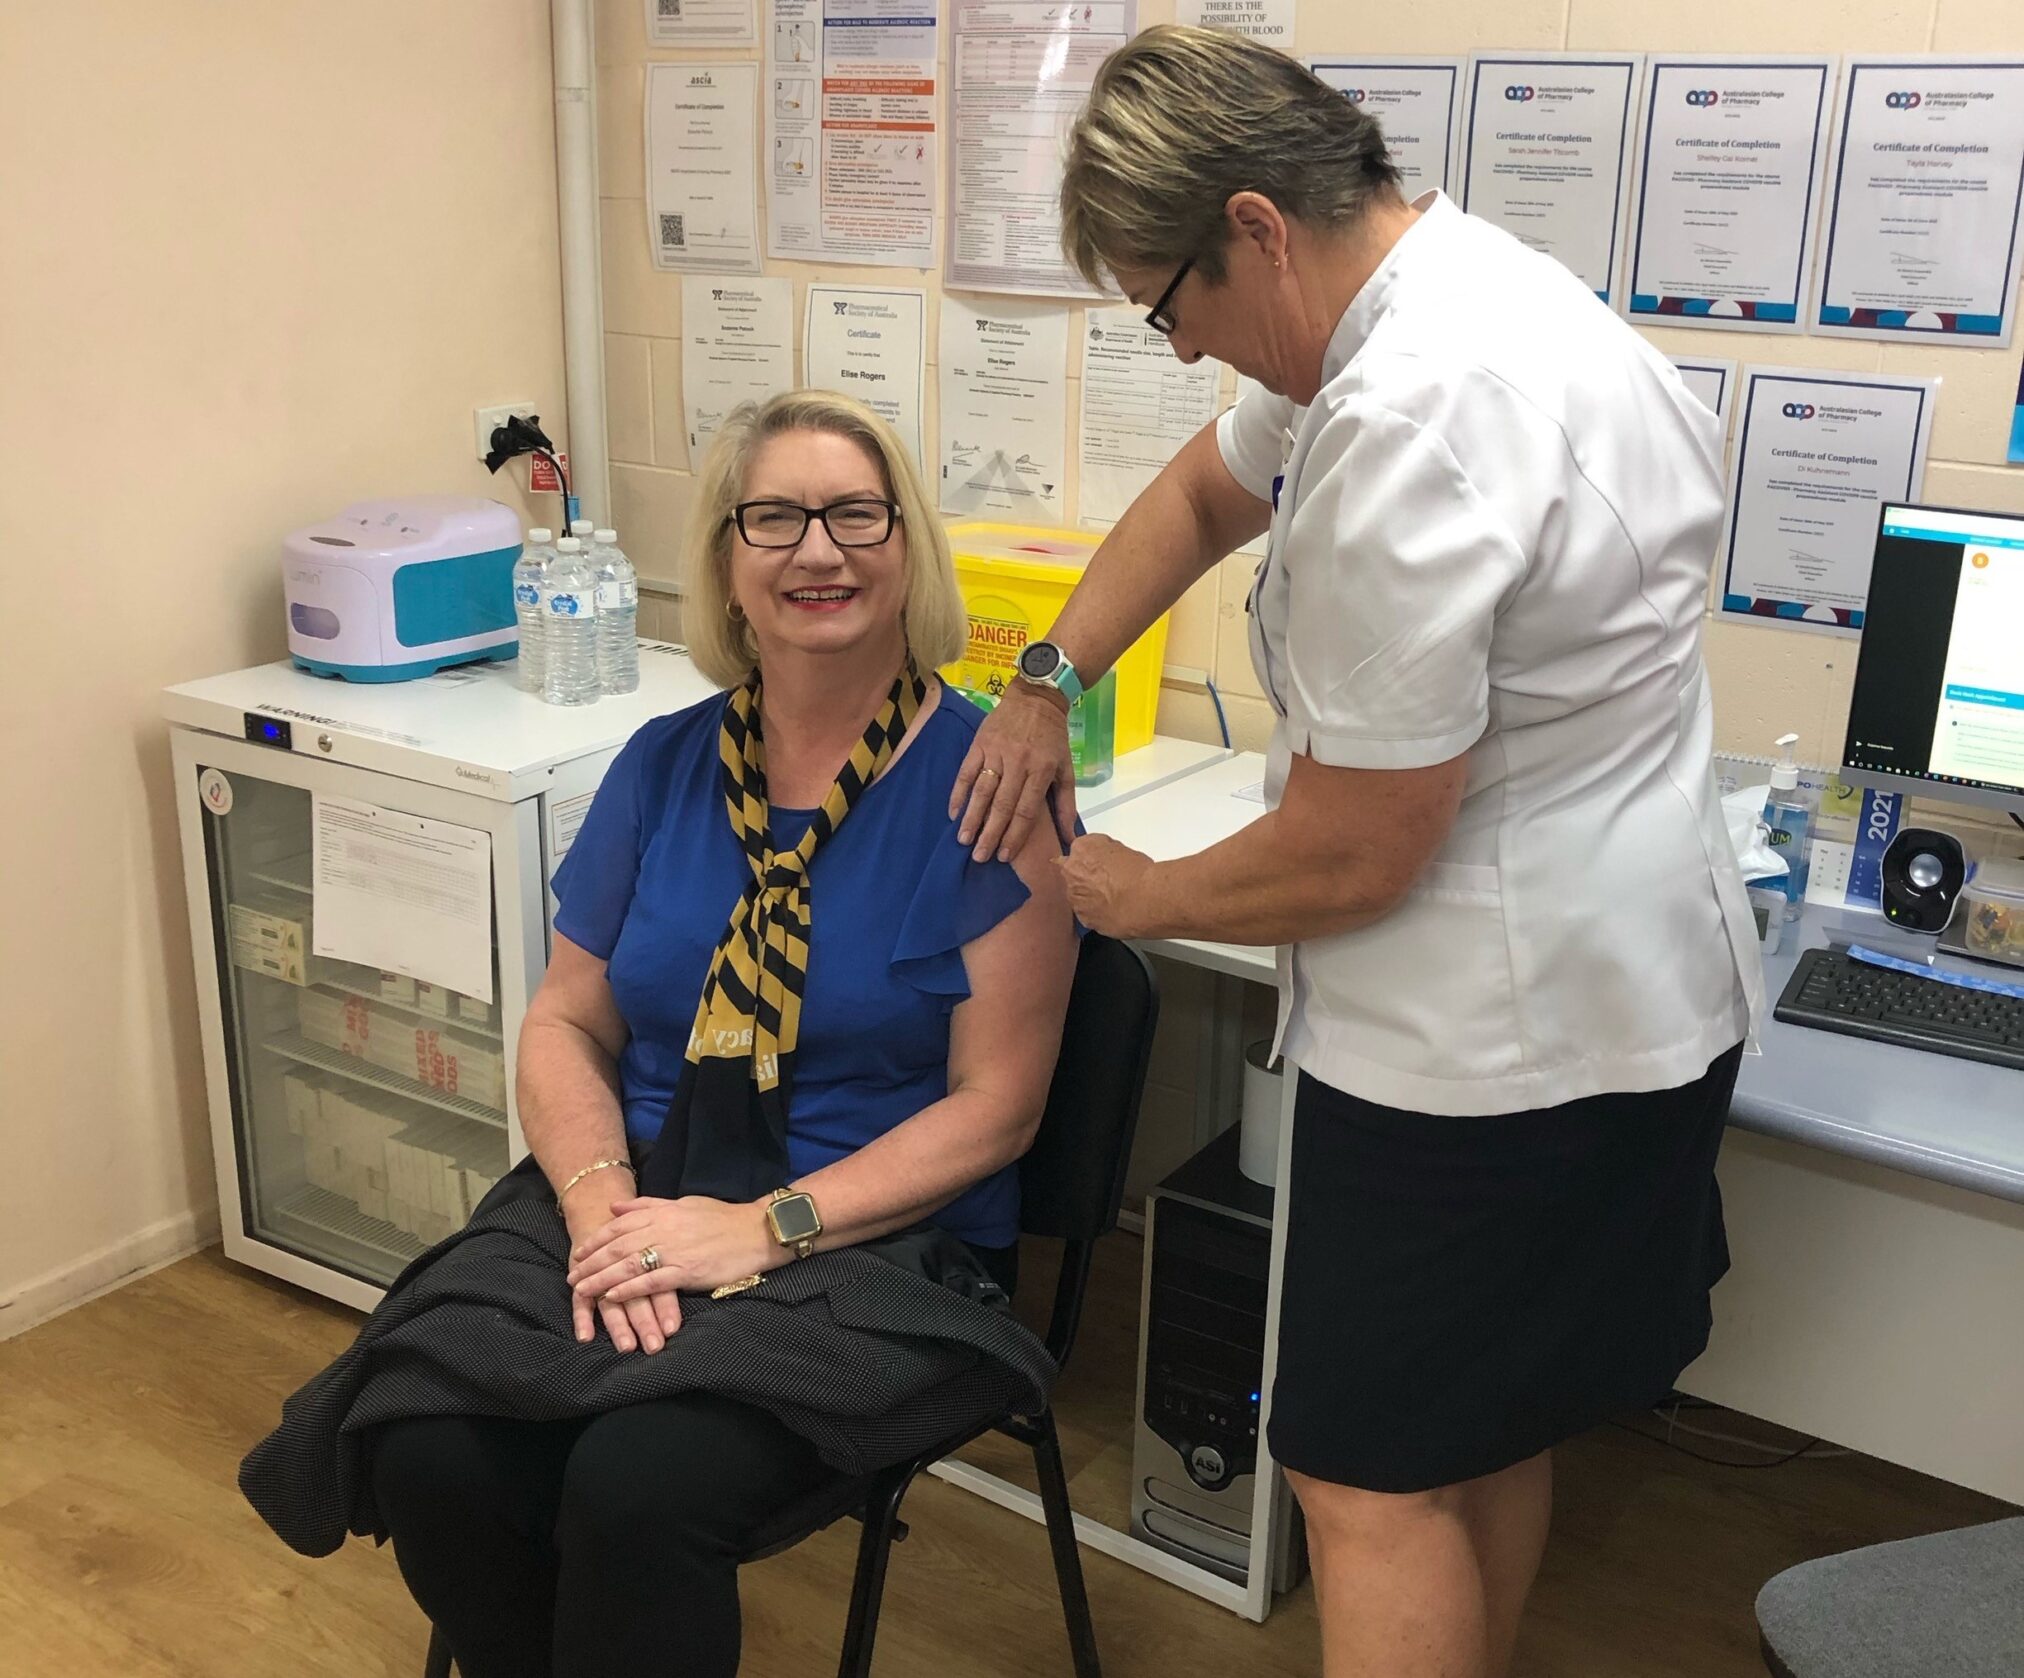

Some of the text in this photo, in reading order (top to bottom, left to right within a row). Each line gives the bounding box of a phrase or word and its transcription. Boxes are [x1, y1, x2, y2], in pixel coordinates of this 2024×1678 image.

[1205, 2, 1262, 10] THERE IS THE
[1201, 14, 1267, 23] POSSIBILITY OF
[1253, 26, 1283, 34] BLOOD
[1574, 87, 1595, 95] College
[1762, 91, 1784, 99] College
[1969, 92, 1994, 100] College
[1730, 98, 1760, 106] Pharmacy
[1933, 100, 1967, 108] Pharmacy
[1496, 132, 1592, 144] Certificate of Completion
[1675, 138, 1781, 150] Certificate of Completion
[1873, 142, 1988, 154] Certificate of Completion
[848, 329, 881, 338] Certificate
[841, 370, 885, 381] Elise Rogers
[1858, 408, 1882, 417] College
[1826, 413, 1857, 423] Pharmacy
[1771, 448, 1878, 466] Certificate of Completion
[534, 461, 550, 470] DO
[256, 703, 335, 725] WARNING!
[1797, 781, 1846, 794] POHEALTH
[1867, 790, 1894, 842] 2021
[1195, 1457, 1220, 1474] ASI
